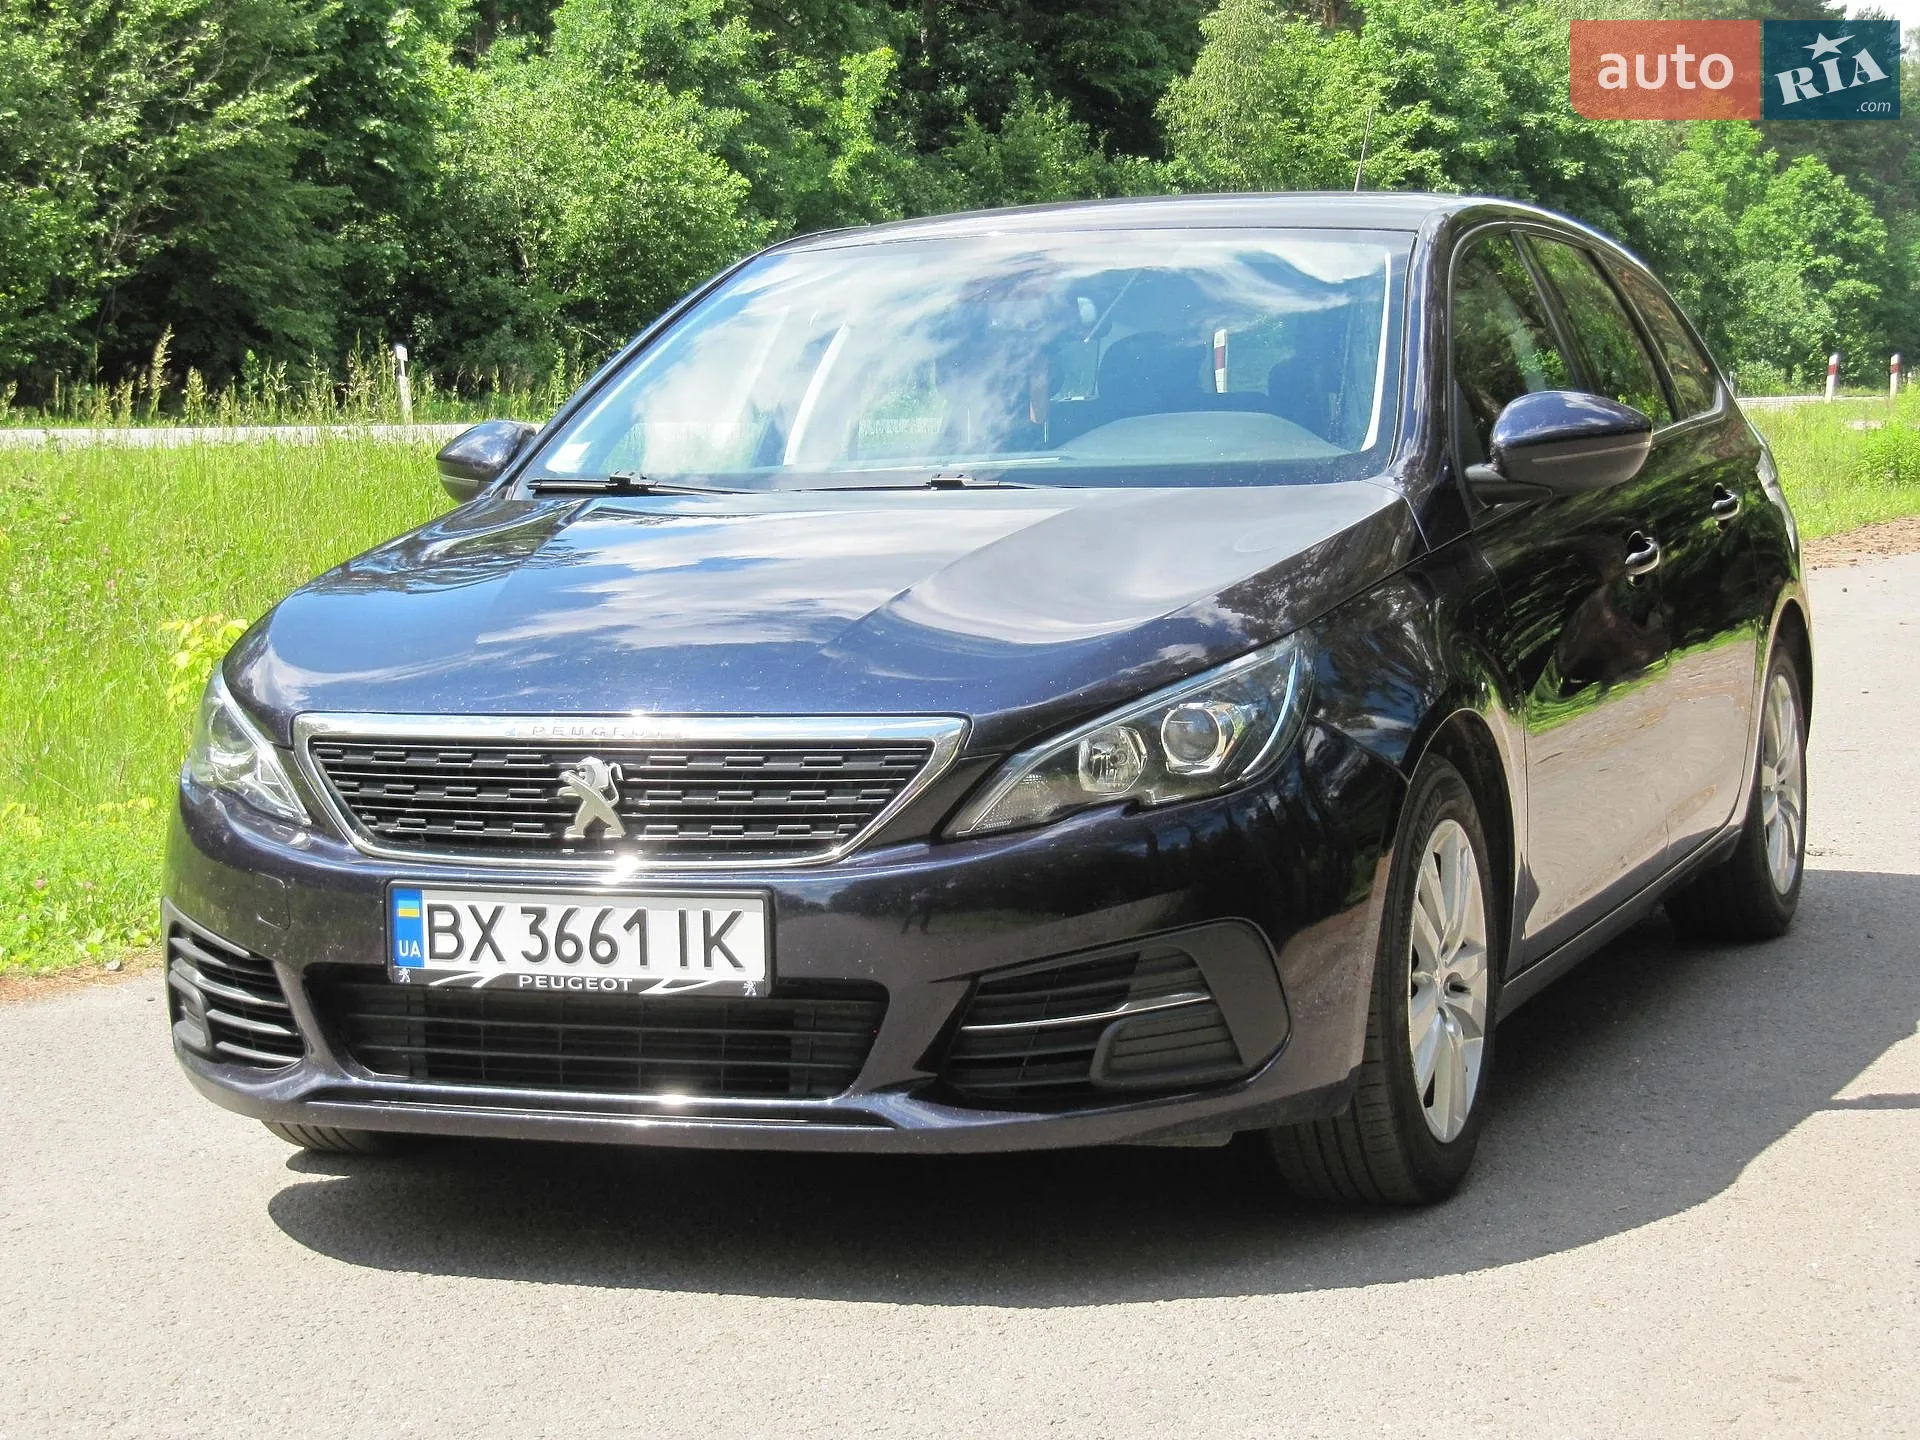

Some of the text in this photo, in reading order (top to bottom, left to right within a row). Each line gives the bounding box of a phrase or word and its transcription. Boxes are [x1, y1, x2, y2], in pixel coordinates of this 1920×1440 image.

[532, 725, 665, 738] PEUGEO
[427, 903, 745, 969] BX 3661 IK
[399, 939, 421, 958] UA
[518, 974, 634, 992] PEUGEOT
